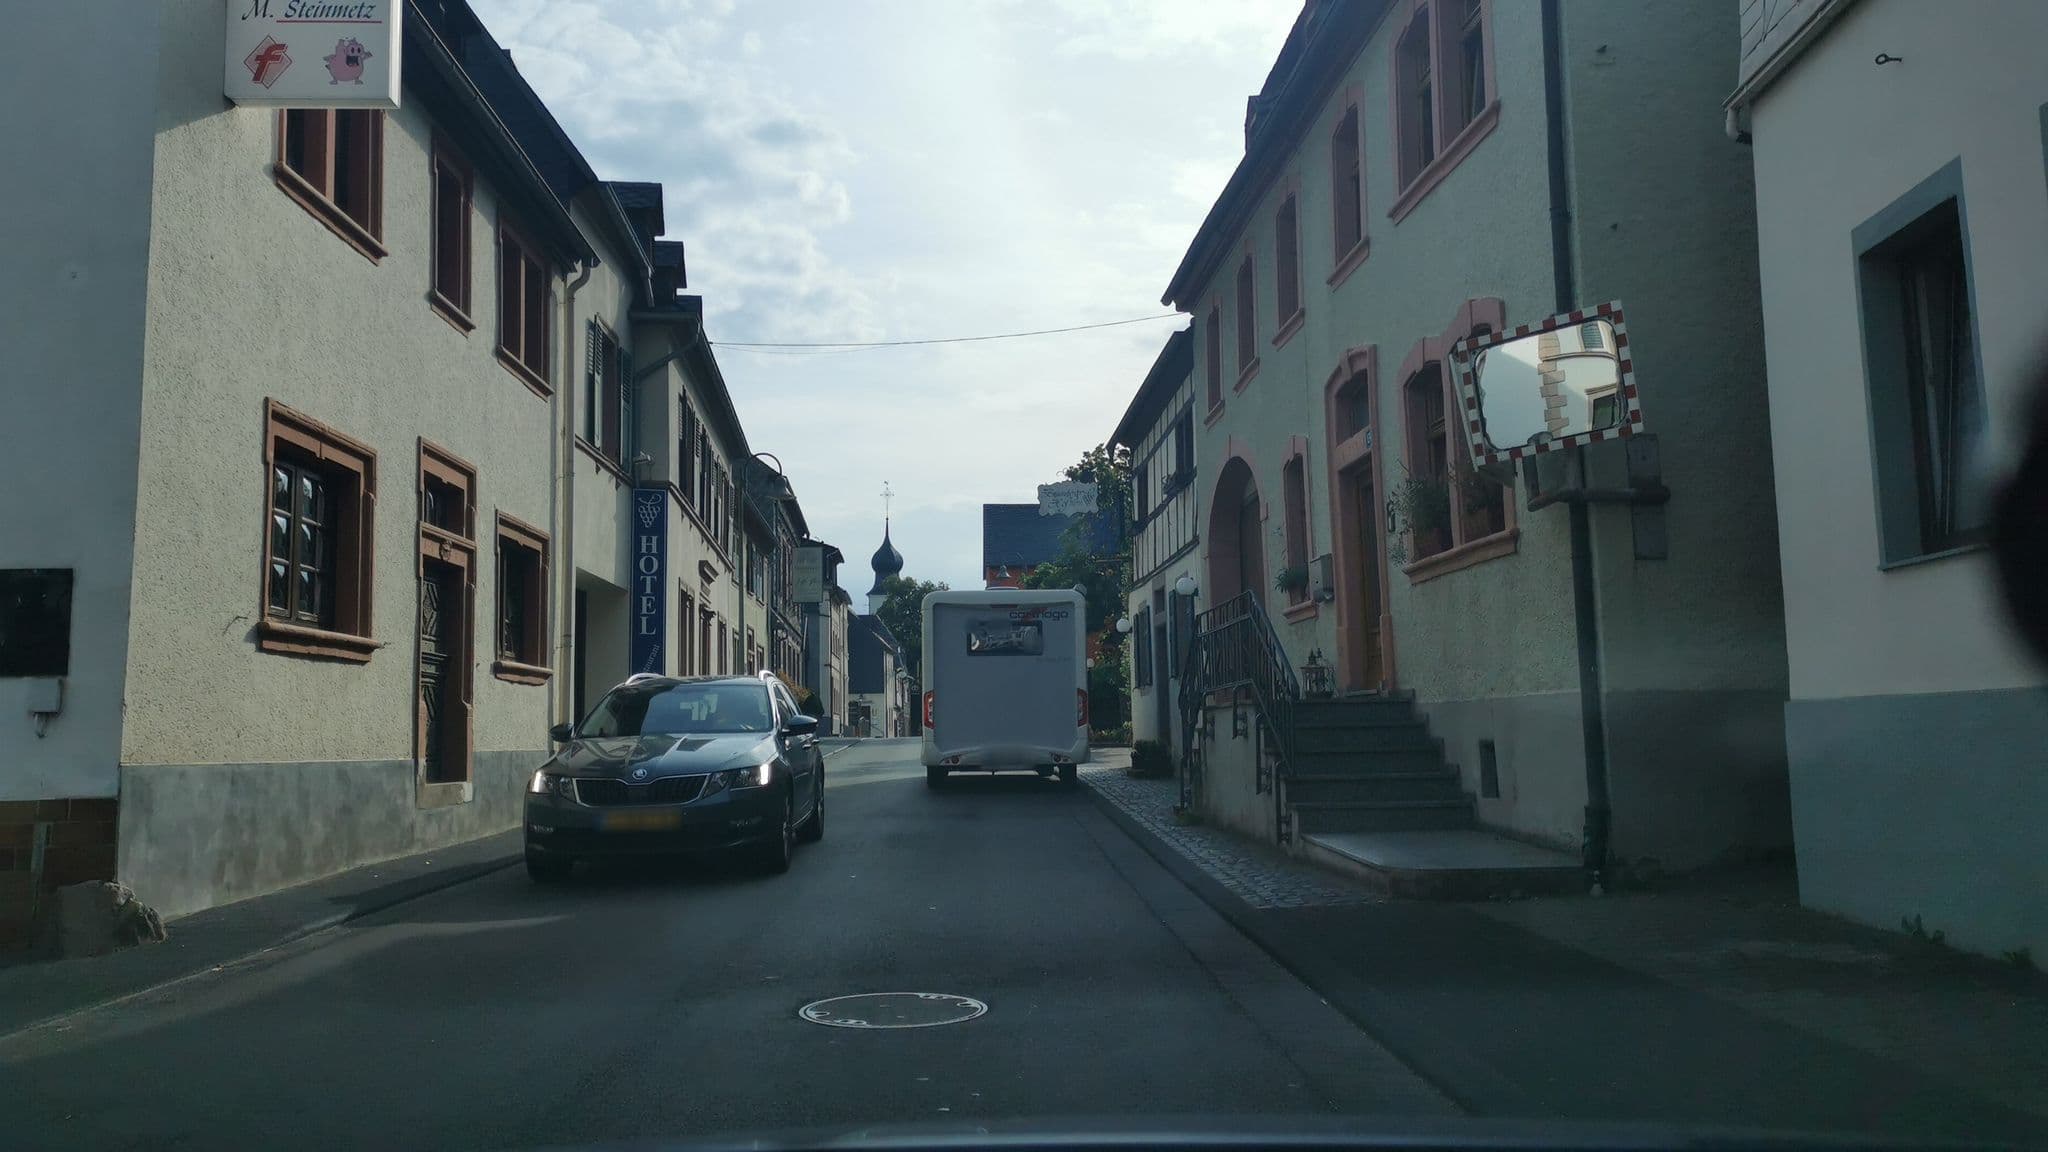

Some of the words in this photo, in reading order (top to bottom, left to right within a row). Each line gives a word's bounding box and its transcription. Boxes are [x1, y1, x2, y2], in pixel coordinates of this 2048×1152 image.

[241, 0, 273, 21] M.
[285, 0, 377, 19] Steinmetz
[639, 535, 659, 635] HOTEL
